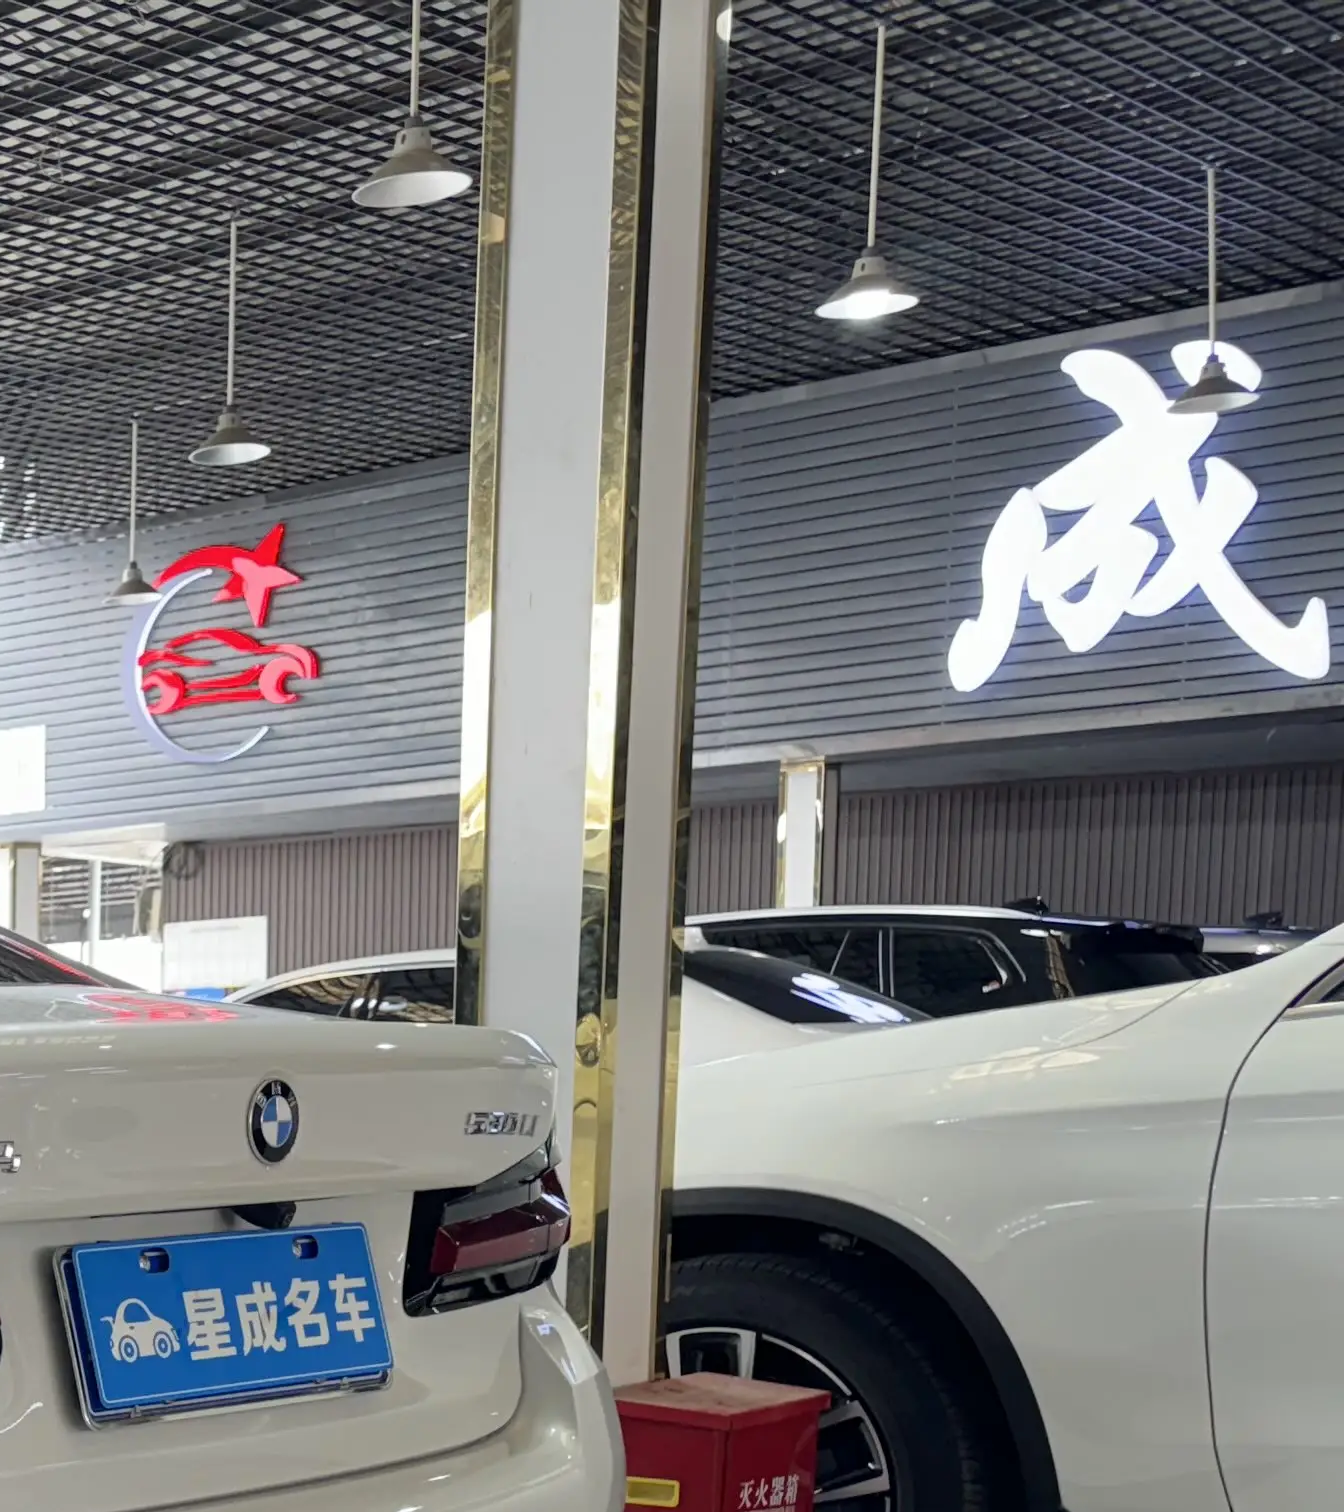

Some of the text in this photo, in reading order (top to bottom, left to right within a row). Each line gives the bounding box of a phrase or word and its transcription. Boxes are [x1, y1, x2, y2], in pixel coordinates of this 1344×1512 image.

[948, 340, 1330, 692] 成
[182, 1273, 377, 1361] 星成名车
[737, 1474, 800, 1509] 灭火器箱
